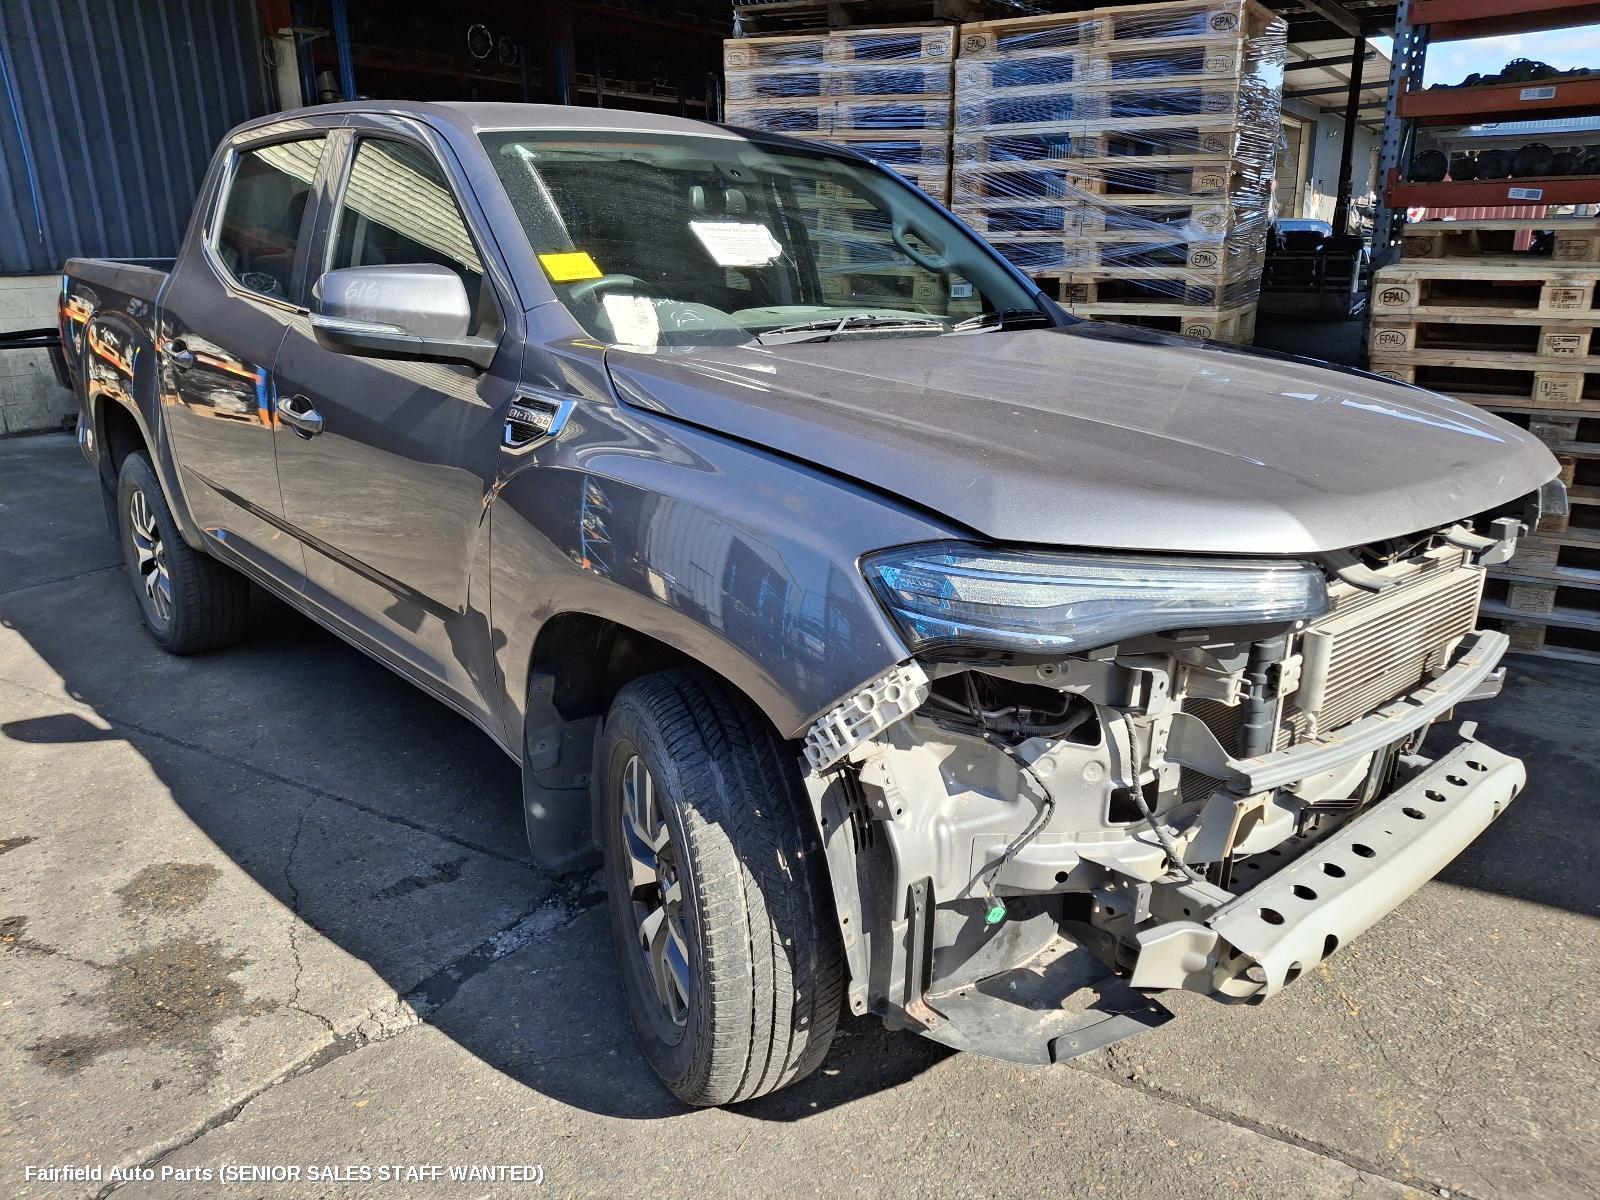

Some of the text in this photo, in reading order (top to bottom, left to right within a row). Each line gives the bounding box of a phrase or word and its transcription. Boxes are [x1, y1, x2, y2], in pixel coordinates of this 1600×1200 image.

[1214, 16, 1233, 27] EPAL
[967, 38, 981, 48] EPAL
[1201, 178, 1219, 188] EPAL
[1194, 254, 1213, 264] EPAL
[1383, 291, 1406, 304] EPAL
[1188, 328, 1208, 337] EPAL
[1379, 334, 1401, 345] EPAL
